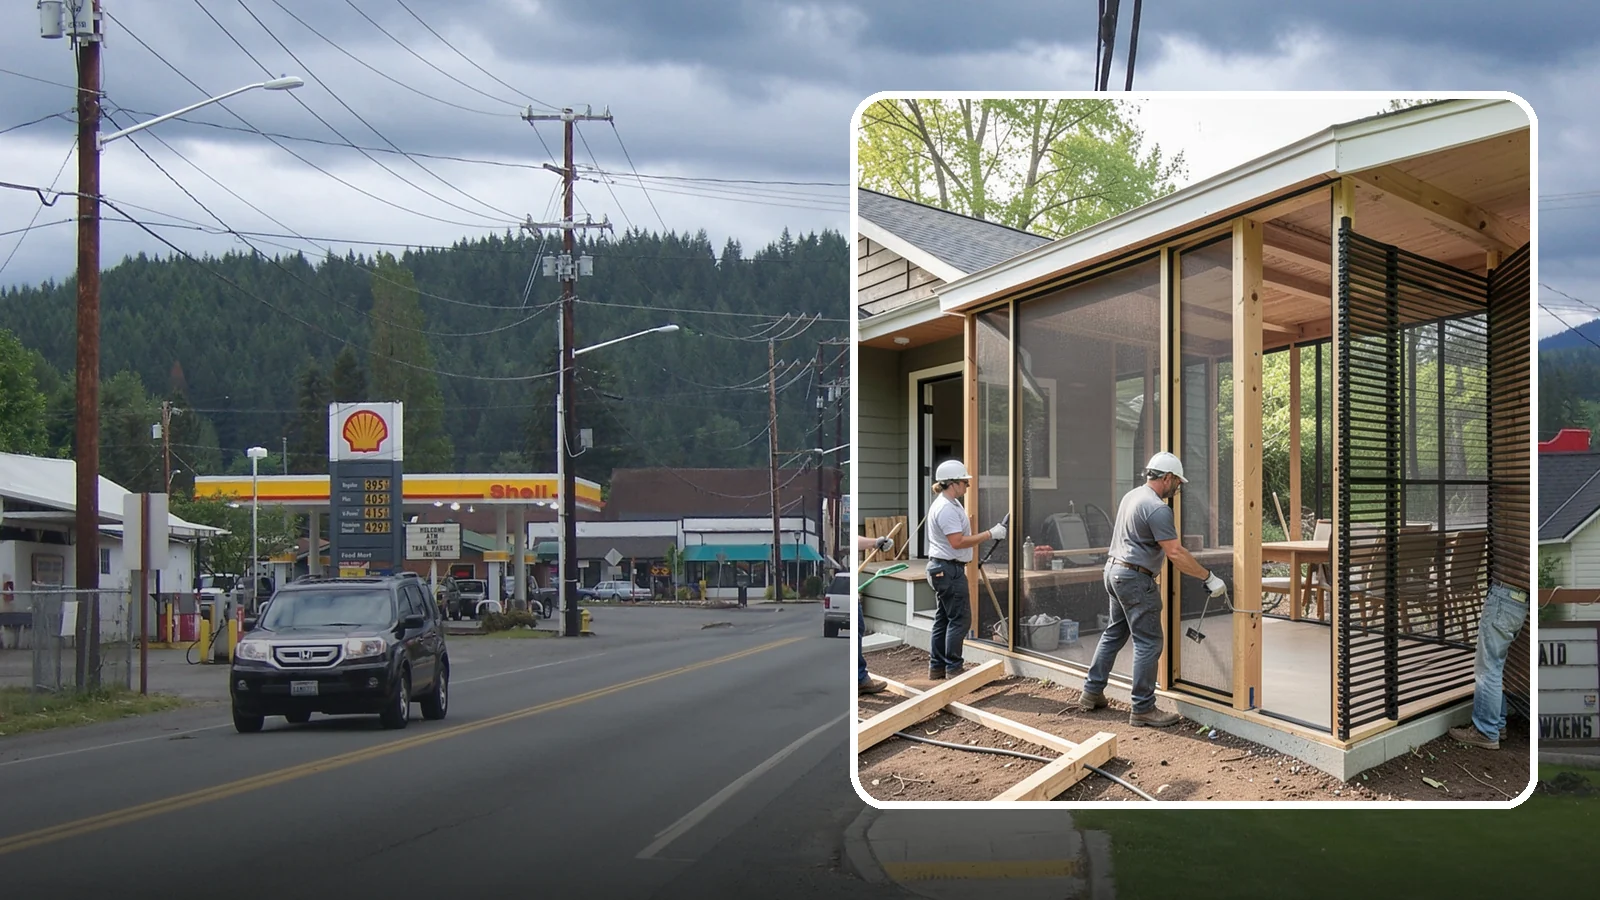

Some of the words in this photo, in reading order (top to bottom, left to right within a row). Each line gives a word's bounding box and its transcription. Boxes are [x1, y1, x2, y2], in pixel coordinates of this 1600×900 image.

[365, 480, 383, 490] 395
[490, 484, 547, 499] Shell
[365, 494, 383, 504] 405
[365, 508, 383, 518] 415
[365, 522, 384, 533] 429
[1538, 643, 1567, 666] AID
